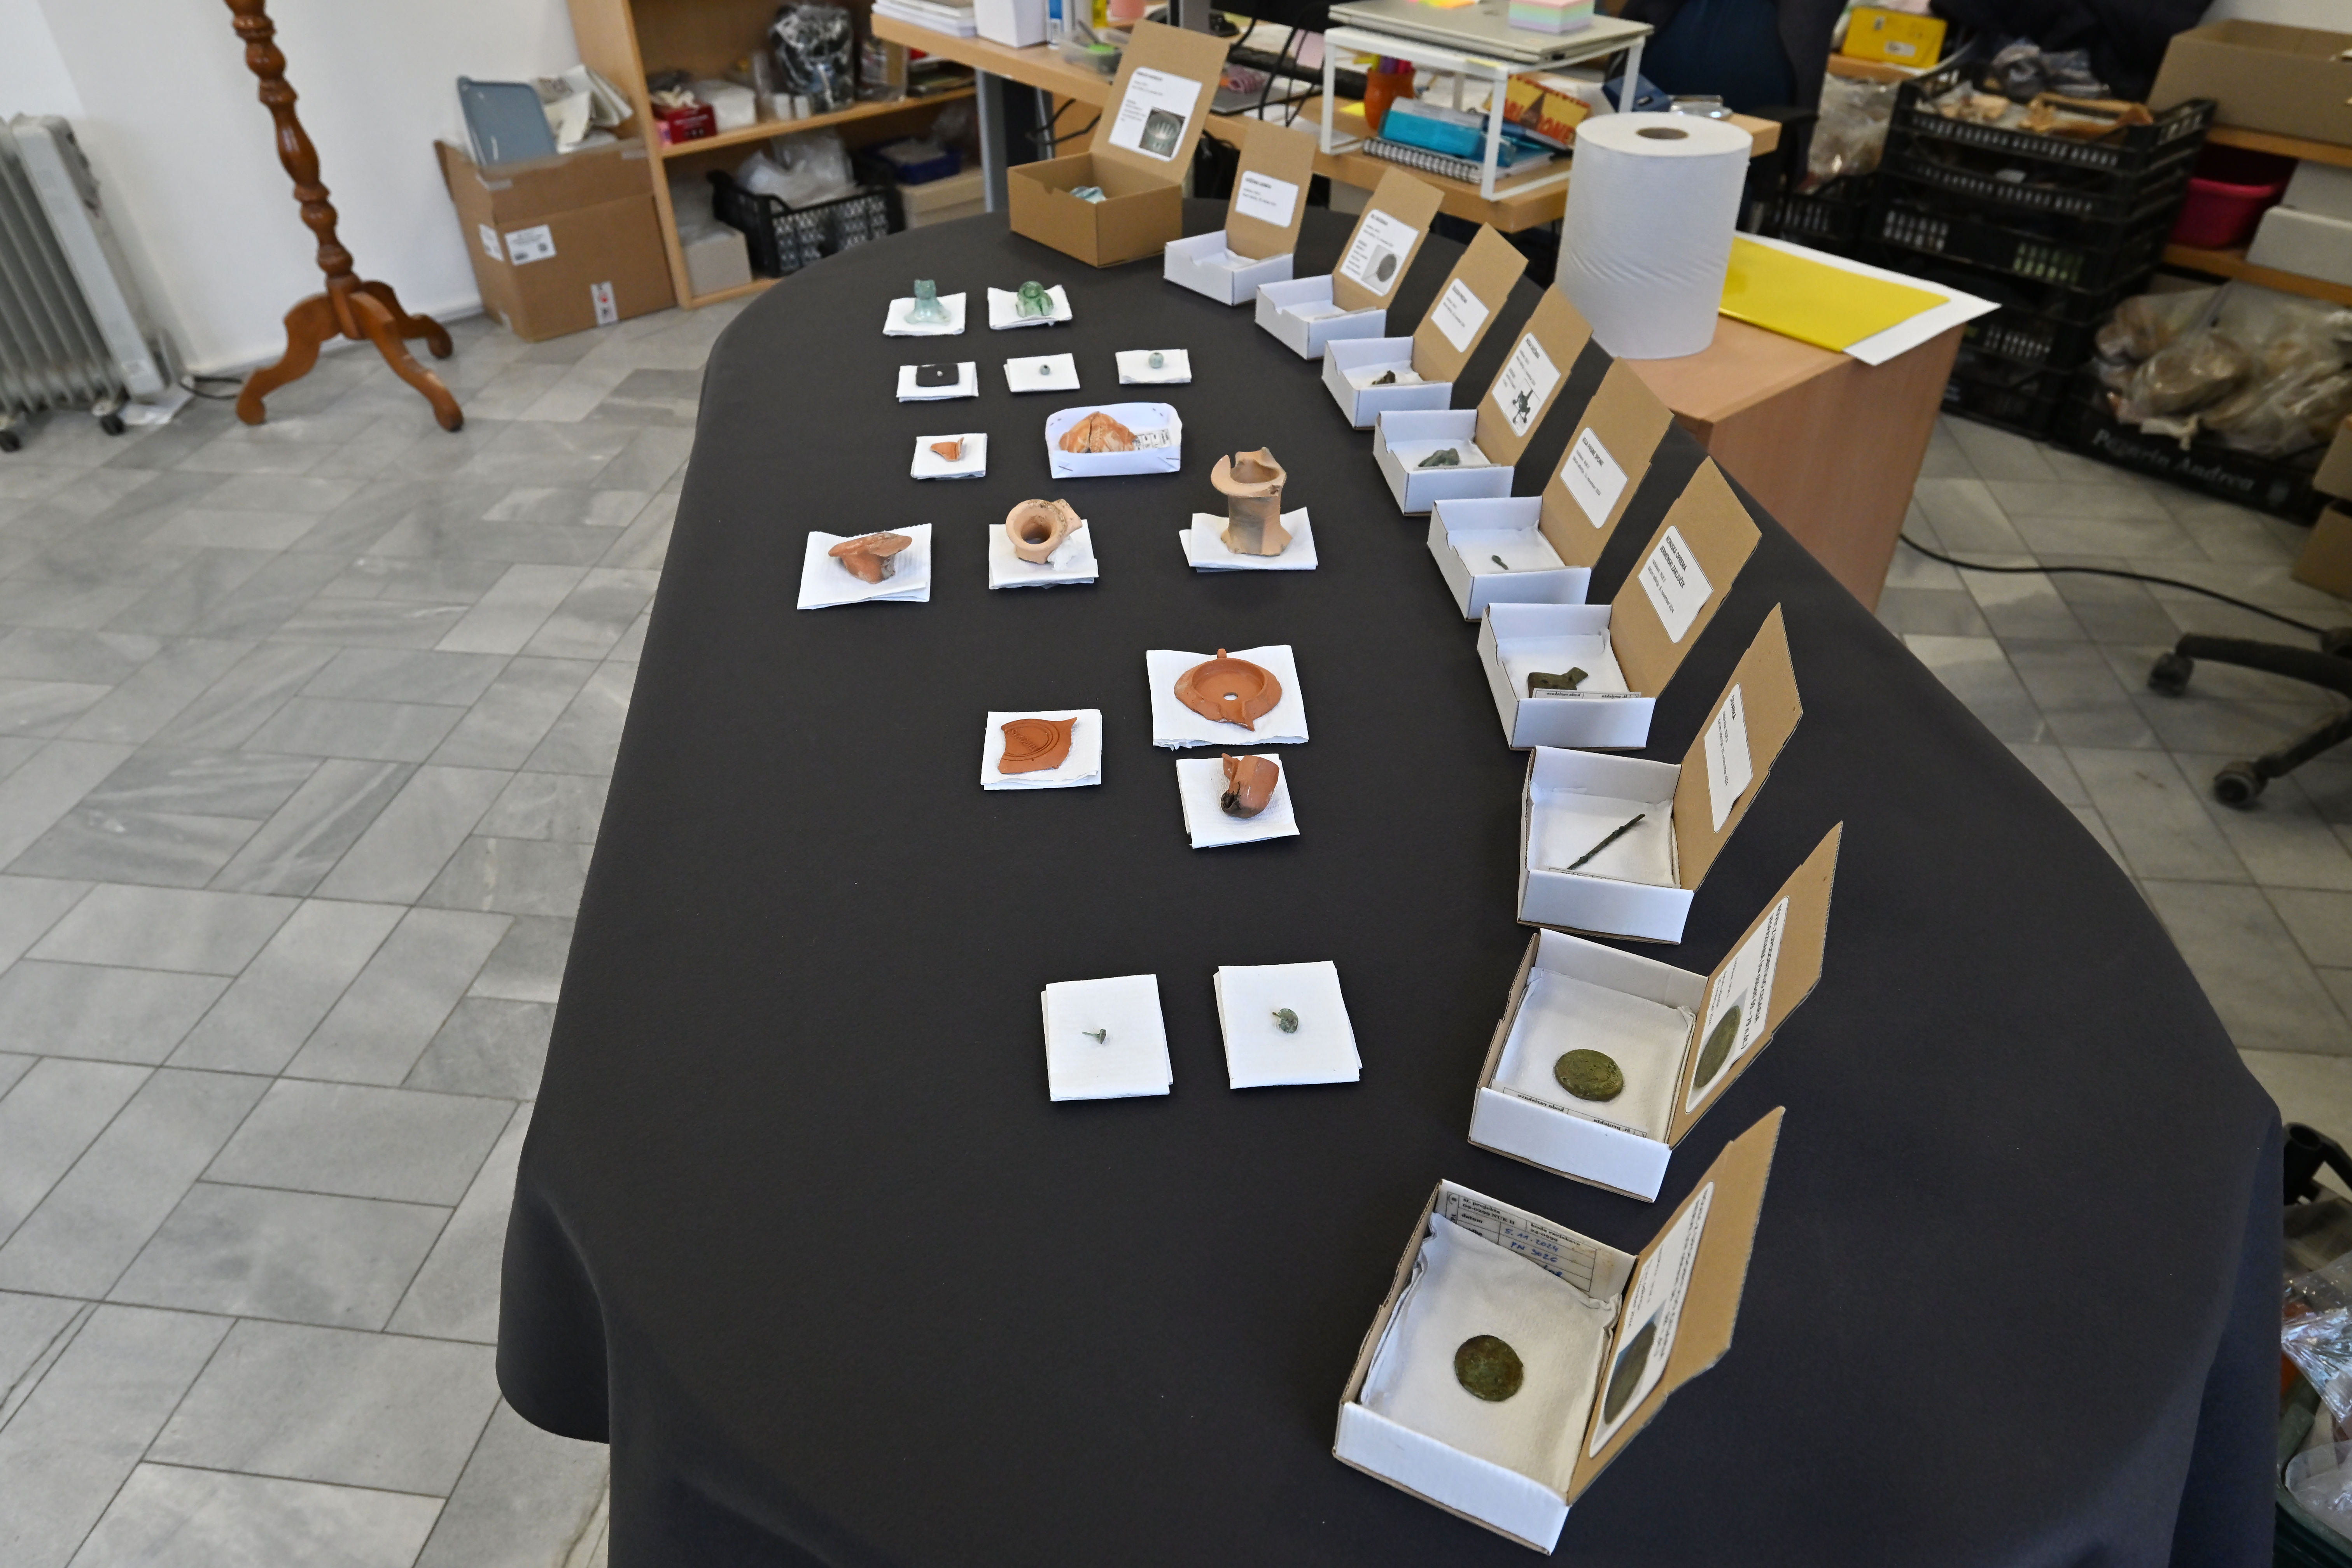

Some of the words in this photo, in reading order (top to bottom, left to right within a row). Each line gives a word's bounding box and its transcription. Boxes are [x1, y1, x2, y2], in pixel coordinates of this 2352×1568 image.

[1659, 545, 1674, 568] JERMENSKI
[1671, 564, 1685, 589] ZAKLJUČEK
[1666, 535, 1677, 555] KONJSKA
[1675, 552, 1687, 572] OPREMA
[1752, 974, 1760, 1001] oblasti
[1754, 989, 1765, 1024] CESARJA
[1461, 1213, 1483, 1223] datum
[1472, 1201, 1500, 1214] projekta
[1535, 1239, 1559, 1252] 2024
